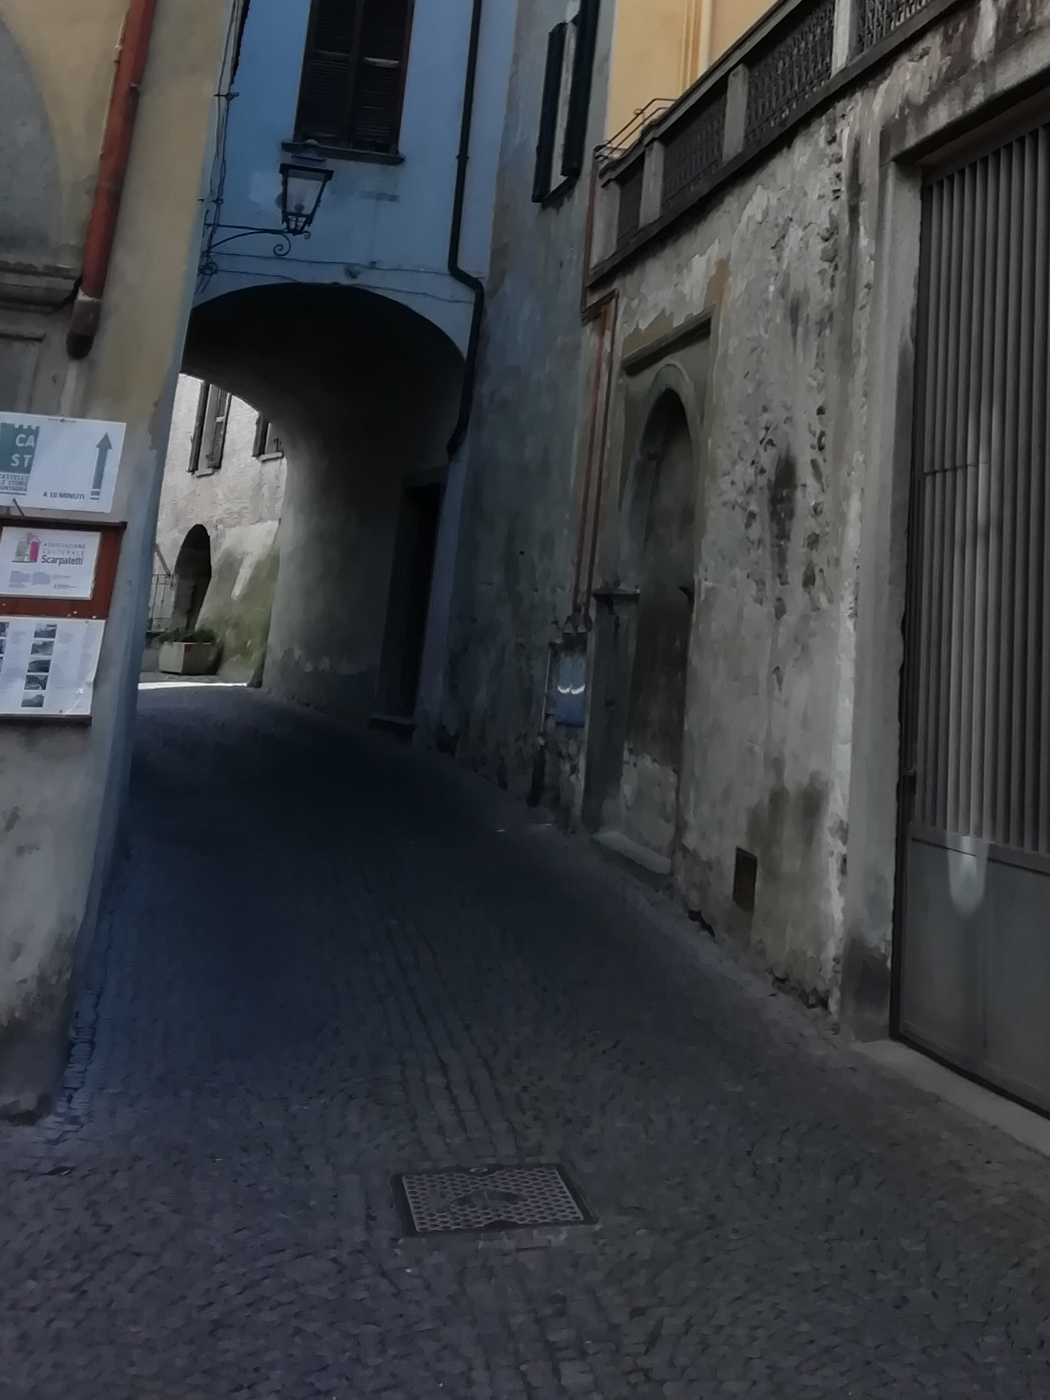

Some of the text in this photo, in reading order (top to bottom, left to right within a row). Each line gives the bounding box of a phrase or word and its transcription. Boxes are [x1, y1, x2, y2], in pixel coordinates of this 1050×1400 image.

[15, 434, 35, 448] CA
[59, 492, 85, 500] MINUTI
[41, 554, 84, 566] Scarpatetti
